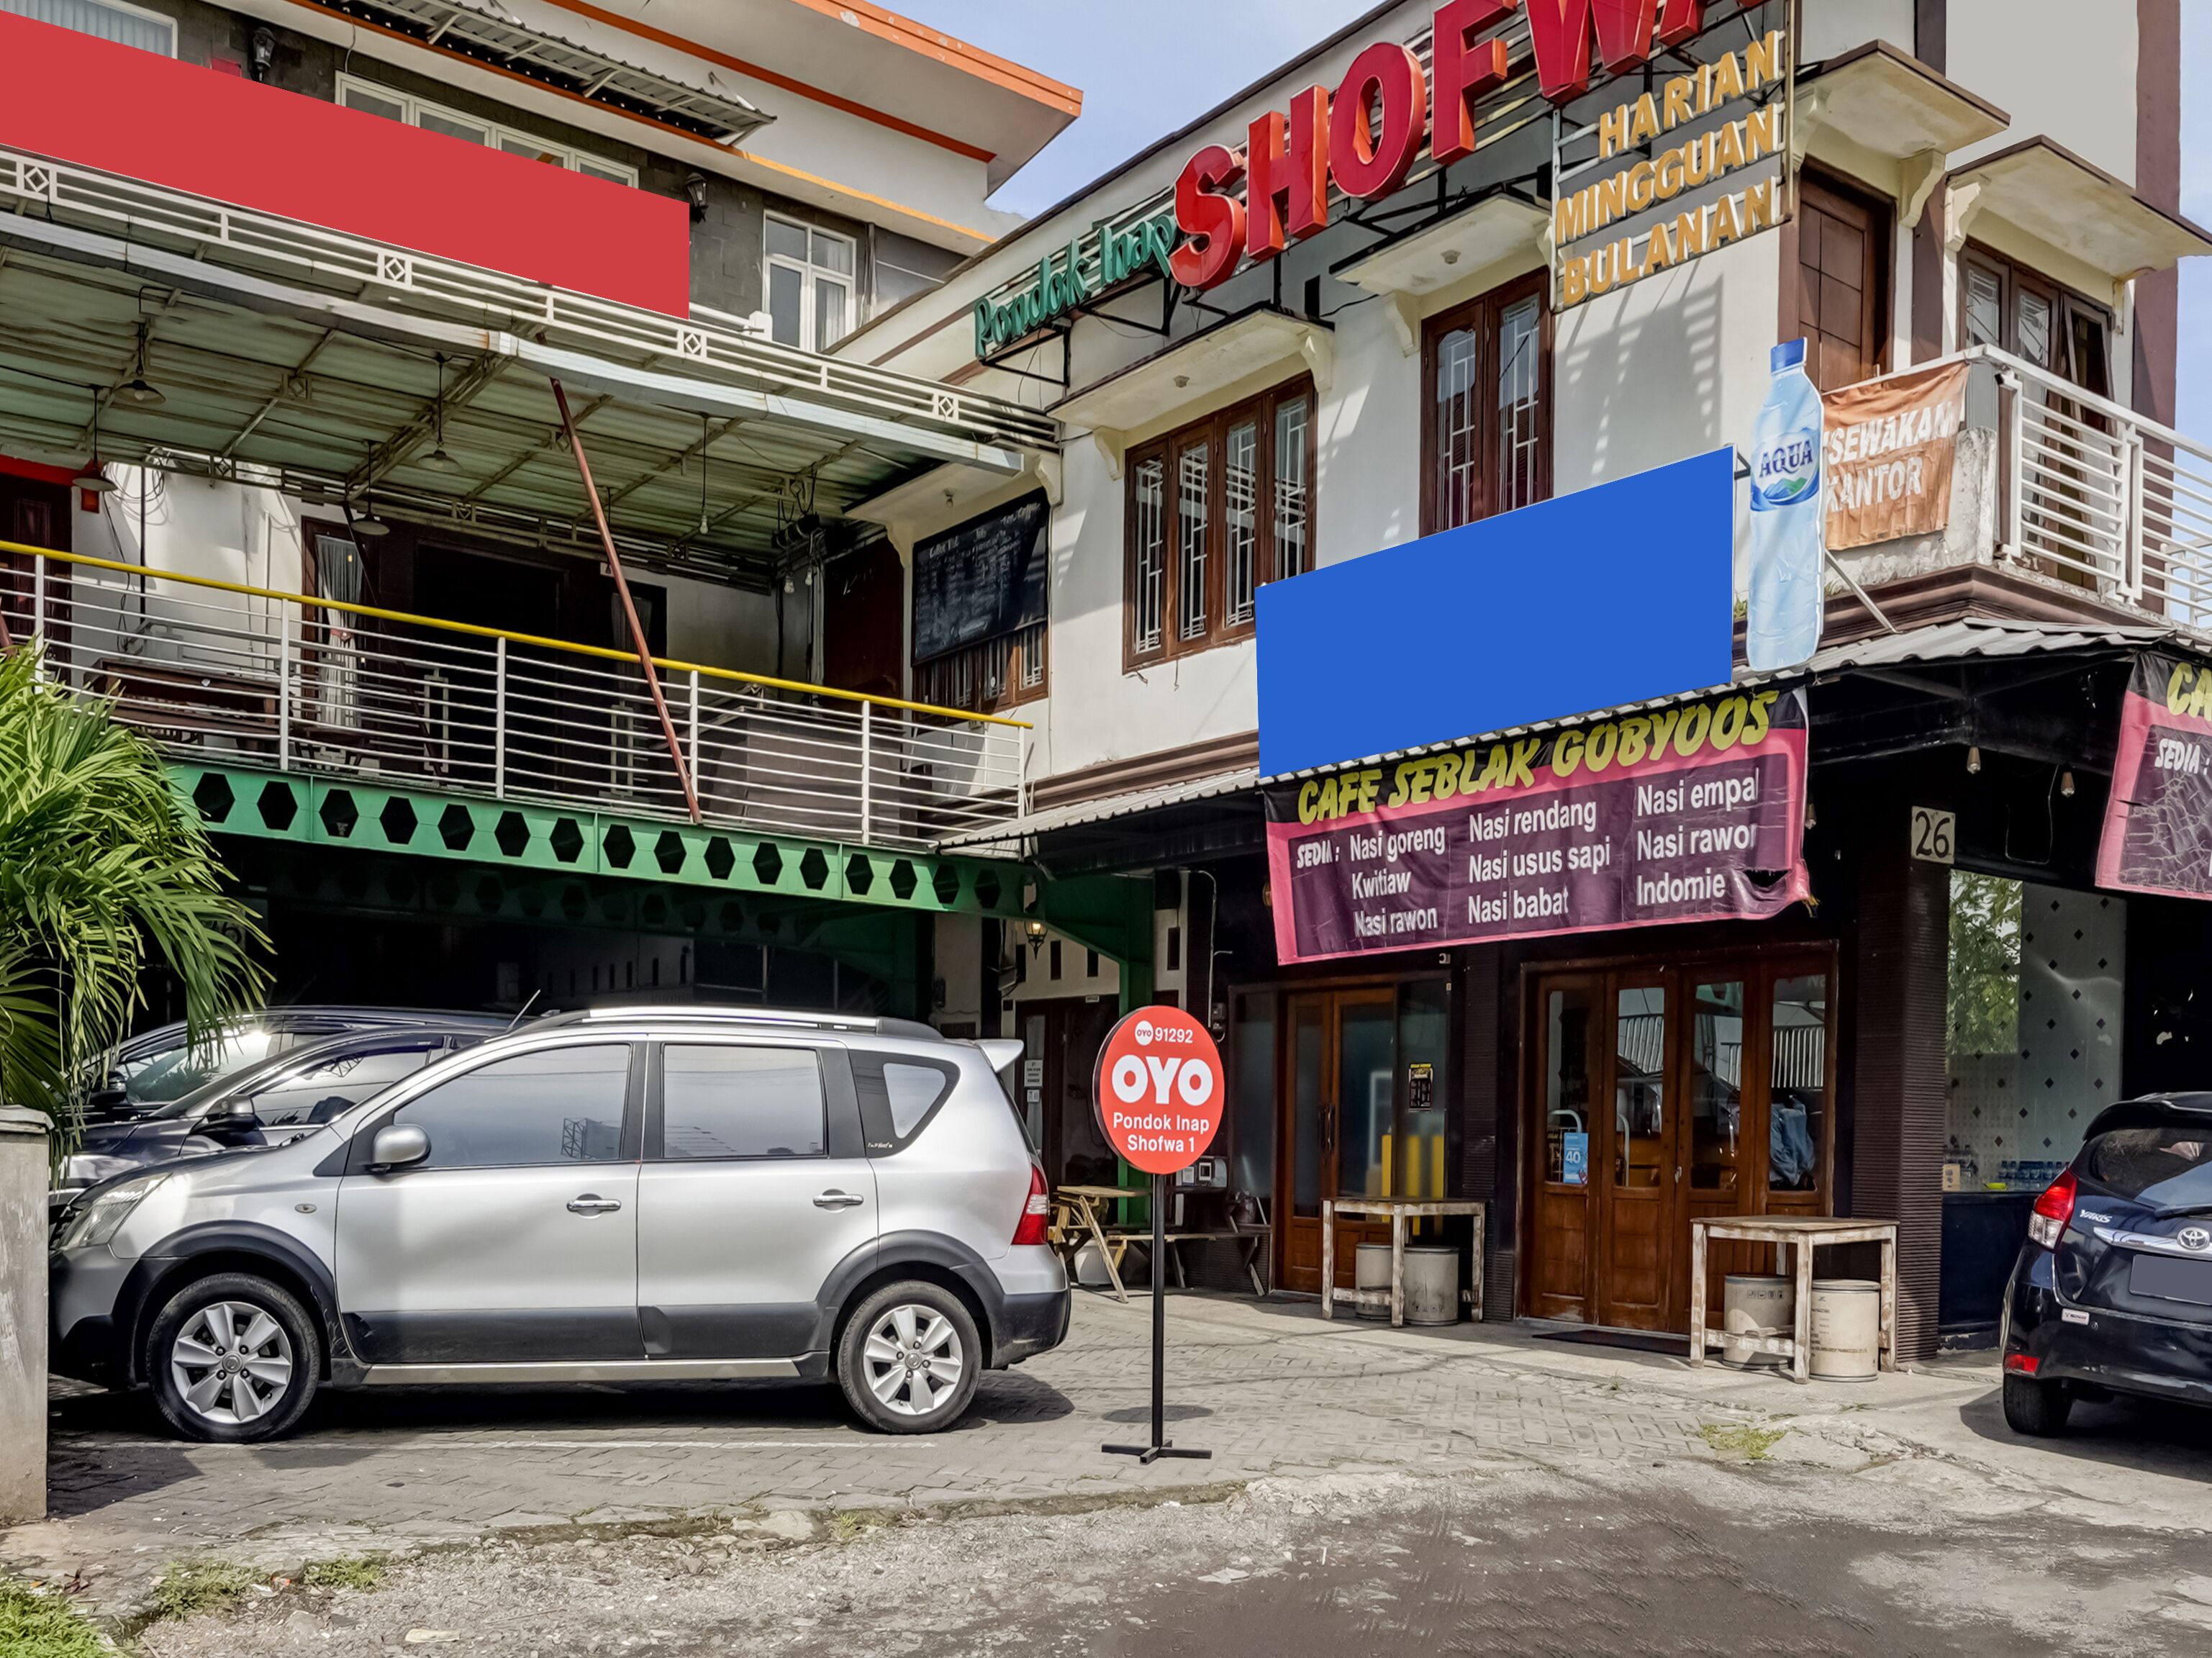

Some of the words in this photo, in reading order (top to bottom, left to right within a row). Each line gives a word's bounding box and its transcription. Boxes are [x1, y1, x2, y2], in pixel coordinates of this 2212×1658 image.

[1599, 30, 1782, 160] HARIAN
[1170, 0, 1772, 291] SHOFW
[1556, 103, 1781, 246] MINGGUAN
[1563, 176, 1780, 306] BULANAN
[974, 237, 1092, 359] Pondok
[1100, 212, 1177, 277] Inap
[1759, 438, 1814, 479] AQUA
[1298, 769, 1382, 825] CAFE
[1387, 738, 1541, 808] SEBLAK
[1551, 690, 1780, 777] GOBYOOS
[2154, 738, 2200, 774] SEDIA
[1637, 779, 1684, 816] Nasi
[1469, 808, 1509, 842] Nasi
[1513, 800, 1597, 835] rendang
[1915, 811, 1951, 858] 26
[1350, 830, 1382, 862] Nasi
[1387, 825, 1446, 863] goreng
[1469, 850, 1508, 883] Nasi
[1513, 849, 1562, 876] usus
[1567, 836, 1610, 874] sapi
[1637, 825, 1683, 861] Nasi
[1352, 869, 1411, 900] Kwitiaw
[1636, 869, 1726, 906] Indomie
[1354, 908, 1386, 938] Nasi
[1390, 907, 1438, 933] rawon
[1468, 892, 1507, 924] Nasi
[1513, 887, 1569, 918] babat
[1154, 1028, 1193, 1043] 91292
[1112, 1054, 1213, 1106] OYO
[1113, 1112, 1171, 1130] Pondok
[1177, 1115, 1209, 1134] Inap
[1128, 1135, 1184, 1152] Shofwa
[1189, 1137, 1195, 1152] 1
[2080, 1209, 2113, 1223] YARIS
